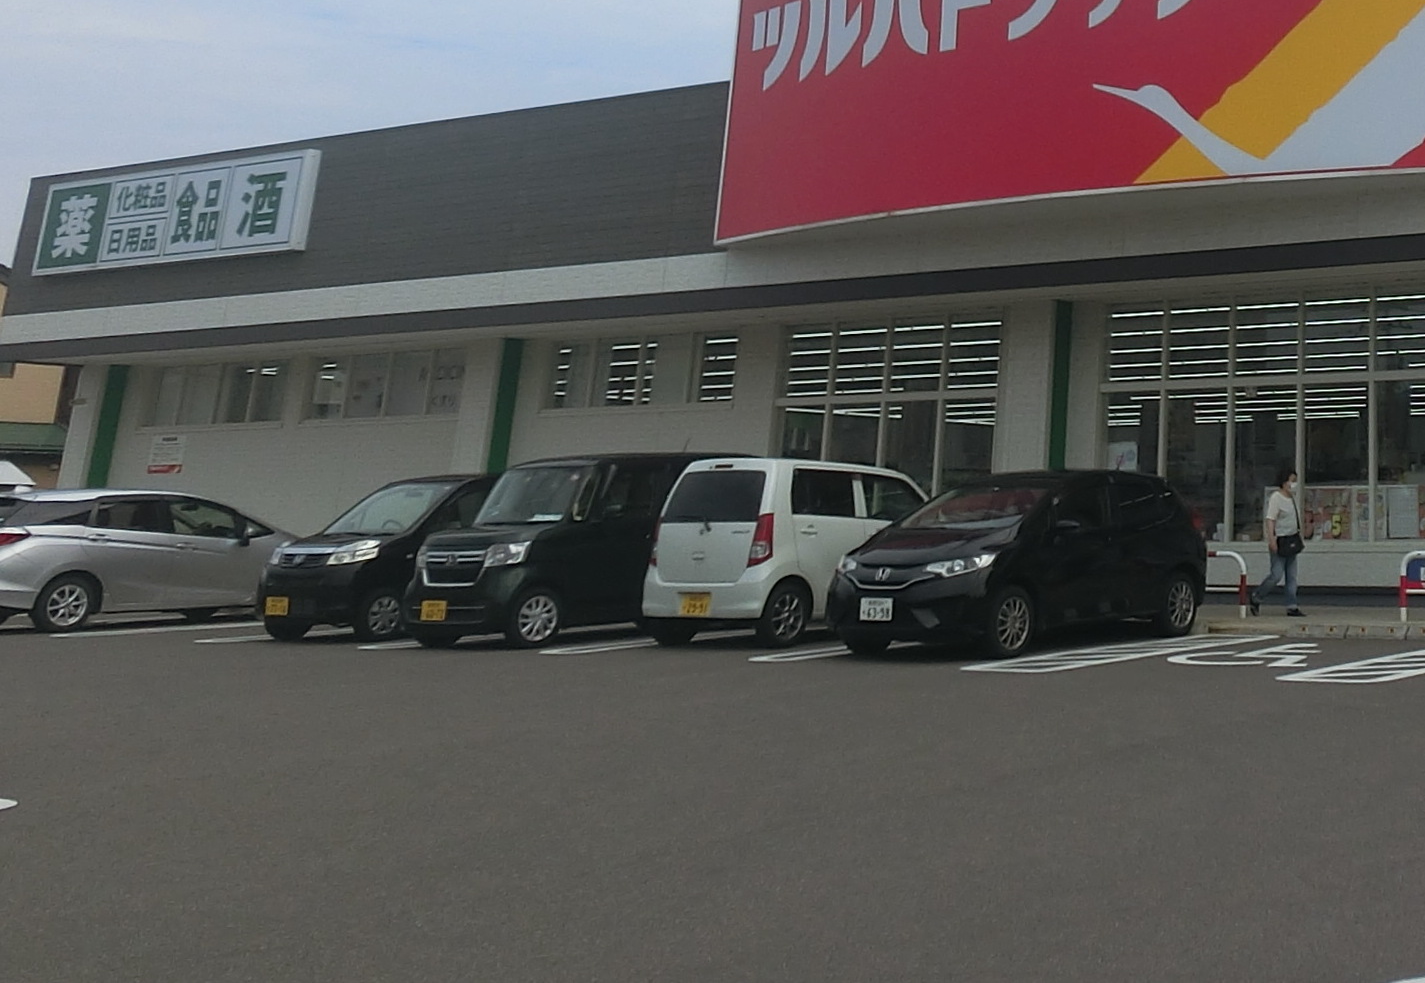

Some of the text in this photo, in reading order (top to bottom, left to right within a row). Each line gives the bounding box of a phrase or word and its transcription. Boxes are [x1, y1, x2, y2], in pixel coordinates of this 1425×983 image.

[51, 194, 98, 258] 薬
[116, 182, 166, 212] 化粧品
[170, 179, 222, 245] 食品
[236, 171, 287, 238] 酒
[106, 225, 157, 255] 日用品
